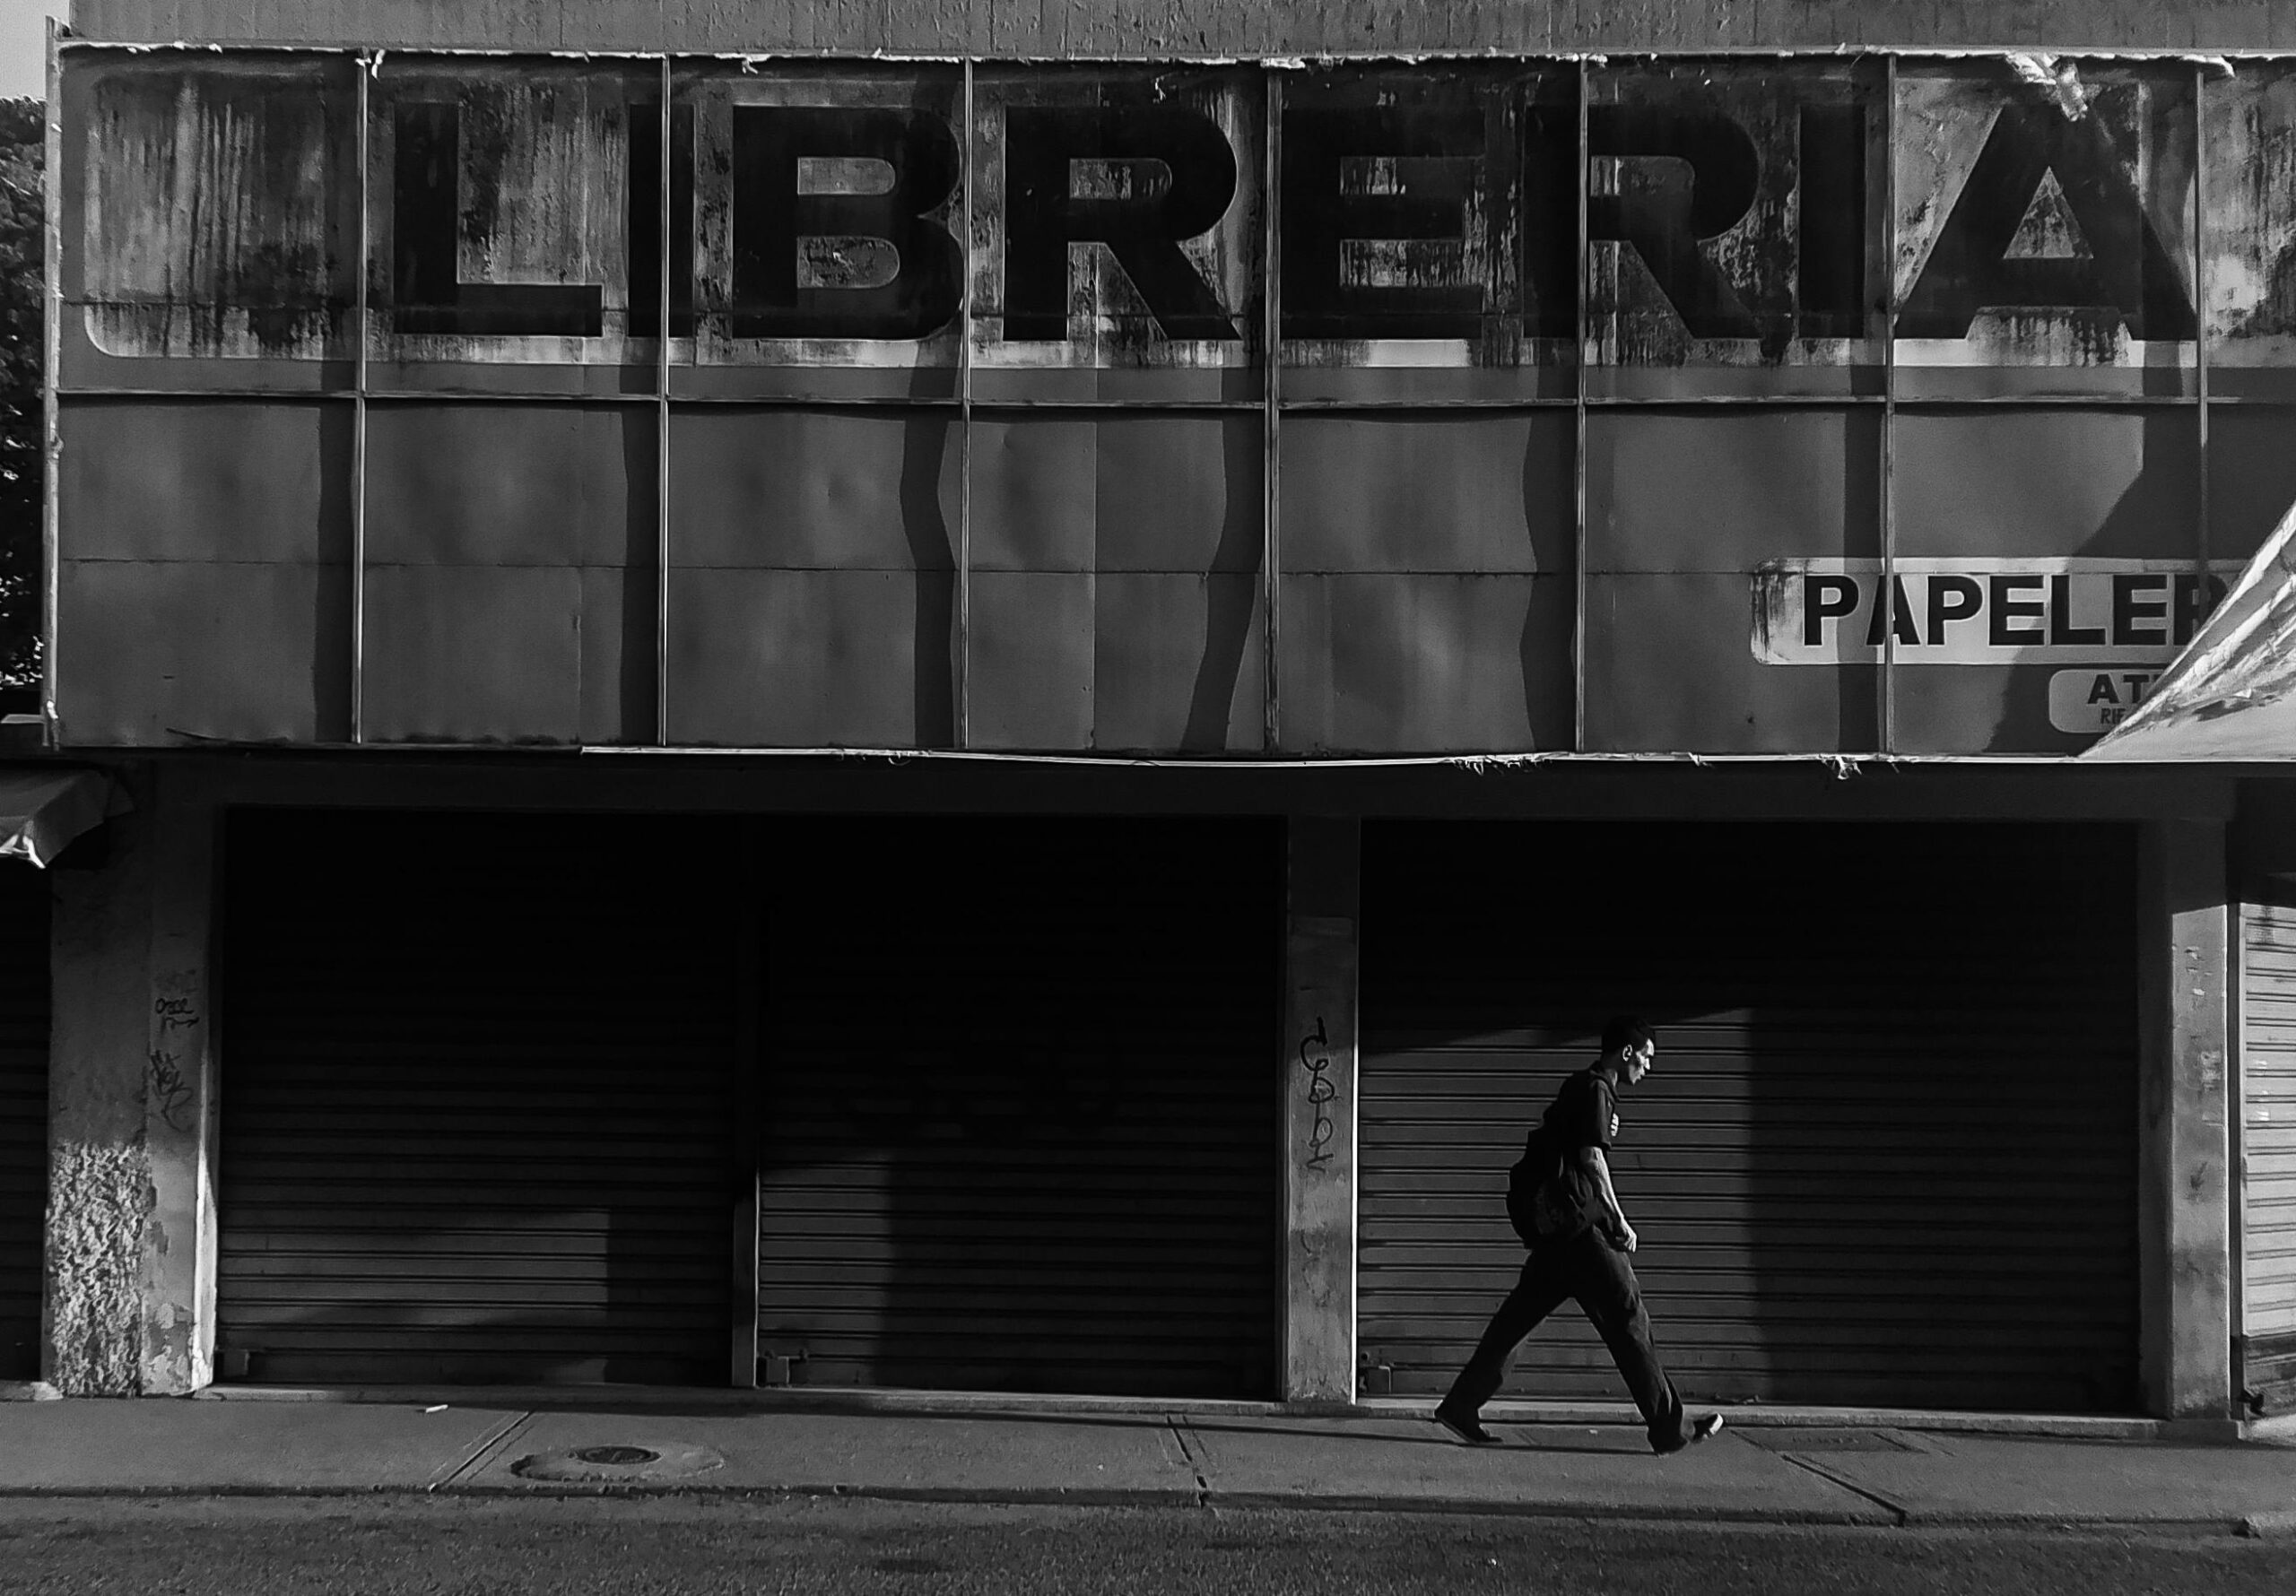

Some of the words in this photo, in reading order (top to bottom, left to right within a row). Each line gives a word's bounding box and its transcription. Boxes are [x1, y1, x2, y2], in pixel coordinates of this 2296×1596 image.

[393, 101, 2199, 341] LIBRERIA
[1804, 573, 2229, 646] PAPELER
[2087, 673, 2162, 705] AT
